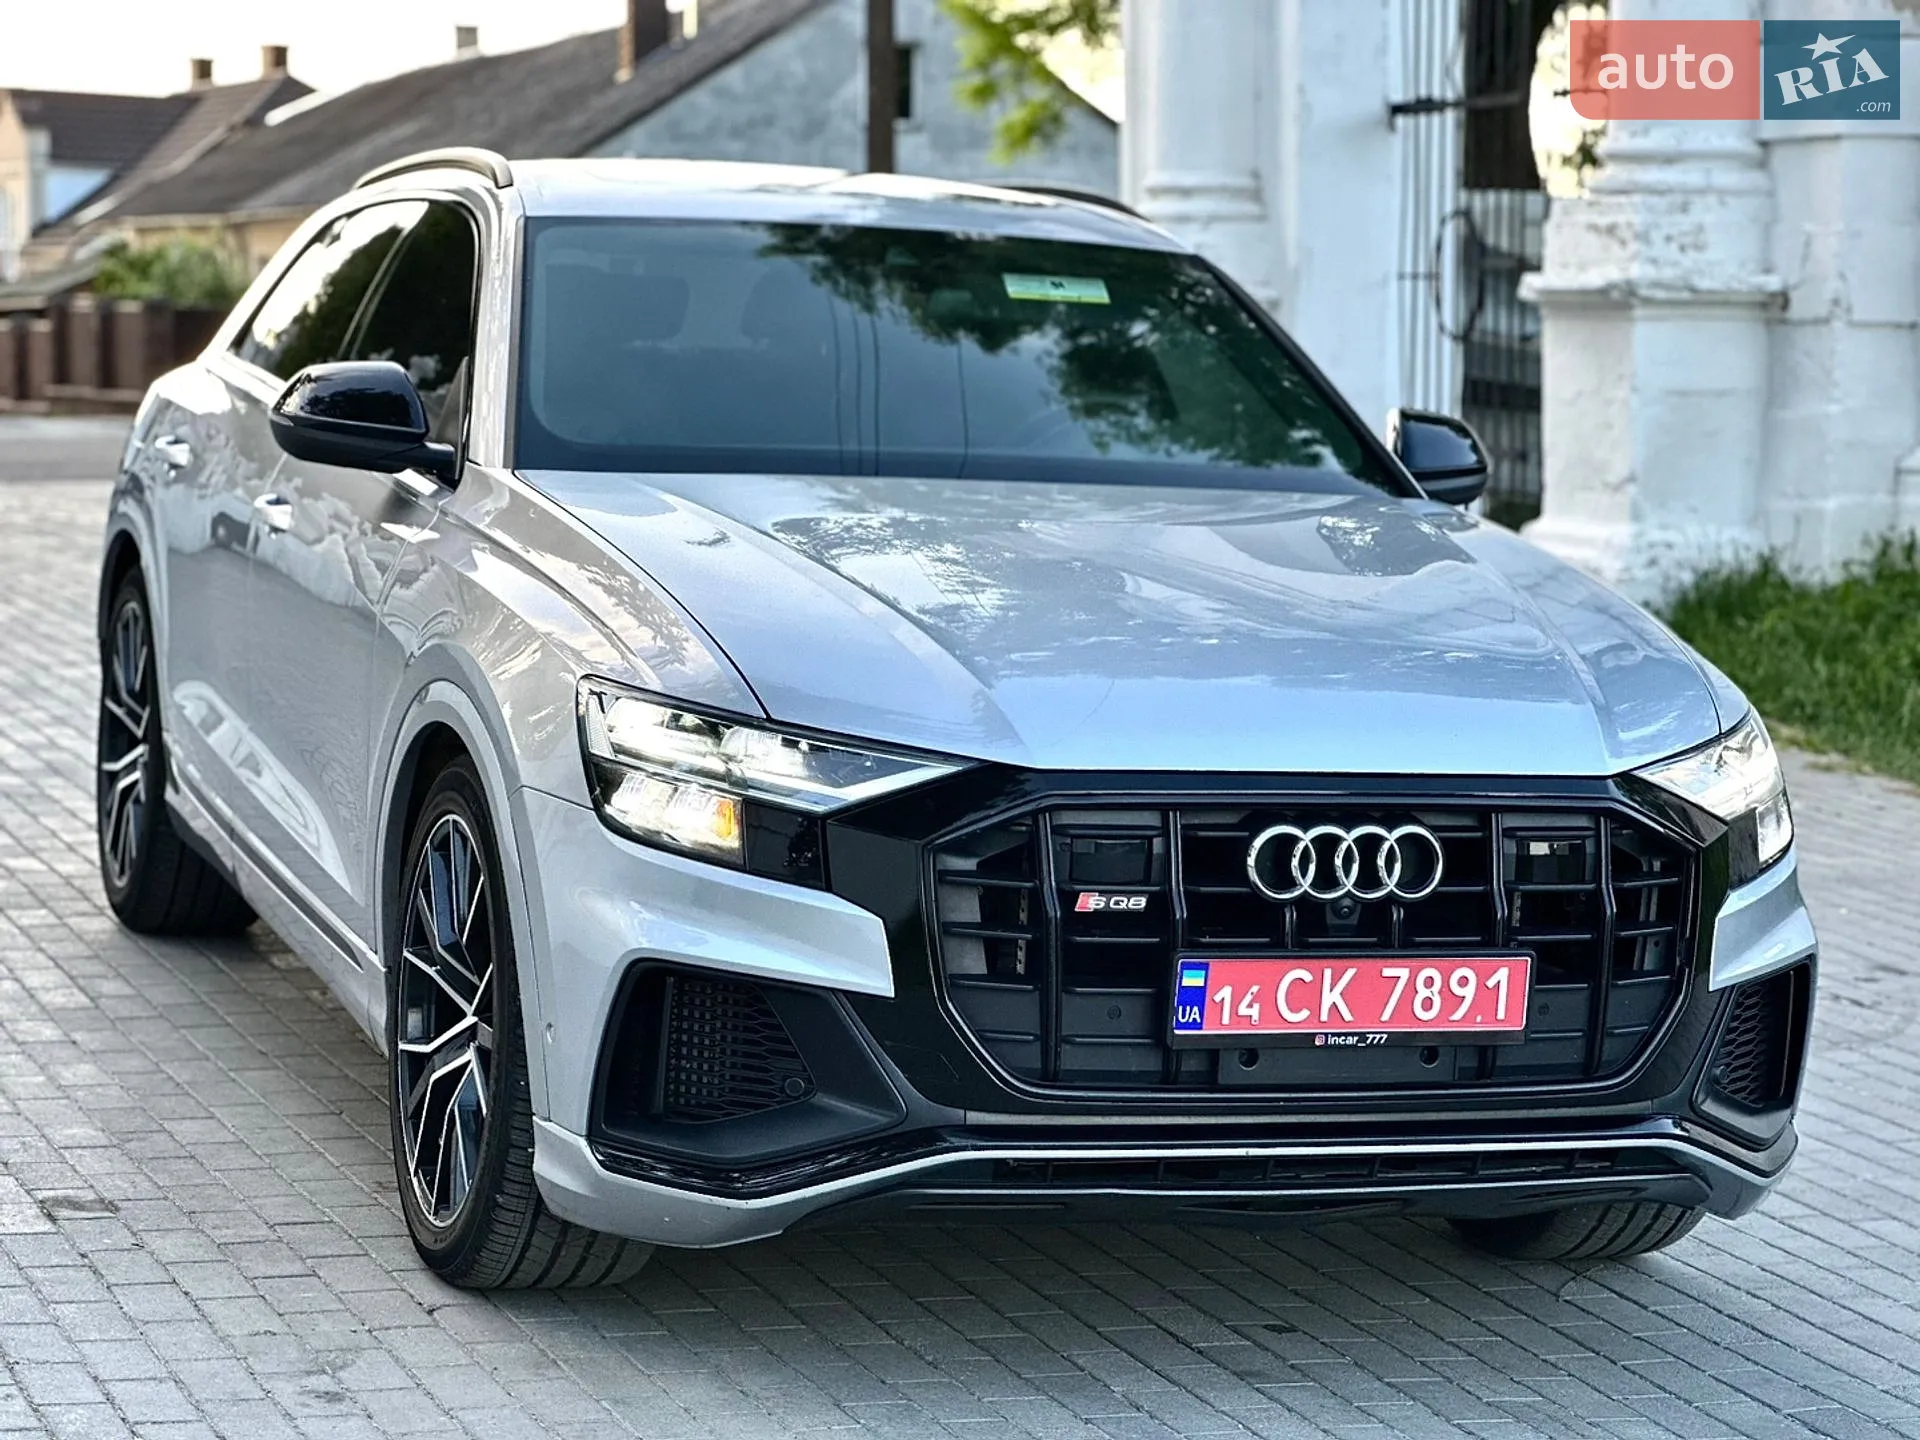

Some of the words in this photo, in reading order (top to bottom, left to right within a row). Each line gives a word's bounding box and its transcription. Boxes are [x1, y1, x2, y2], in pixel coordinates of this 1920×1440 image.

[1212, 985, 1261, 1026] 14
[1276, 966, 1358, 1024] CK
[1379, 966, 1510, 1022] 7891
[1178, 1005, 1201, 1024] UA
[1327, 1033, 1389, 1047] incar_777
